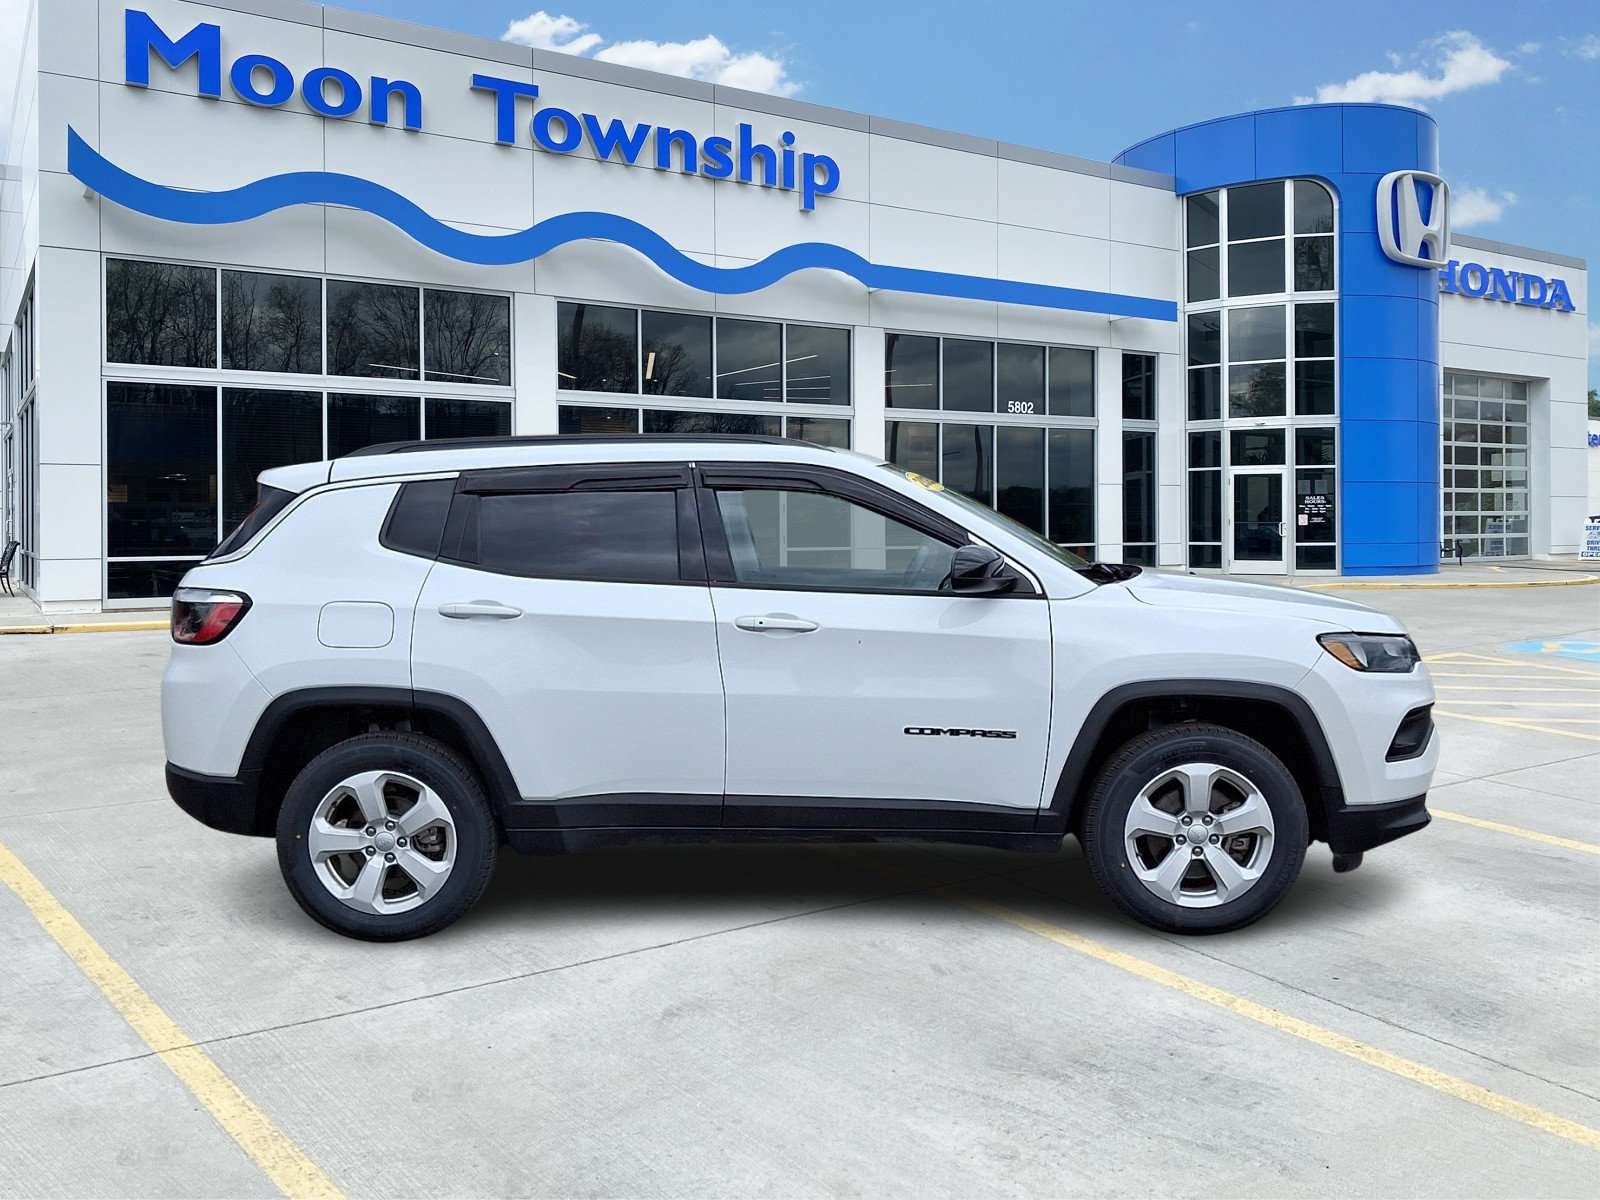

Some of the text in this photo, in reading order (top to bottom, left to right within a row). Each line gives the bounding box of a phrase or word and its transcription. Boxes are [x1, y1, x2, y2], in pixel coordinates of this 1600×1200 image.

[125, 8, 841, 212] Moon Township
[1007, 400, 1035, 414] 5802
[904, 727, 1017, 739] COMPASS
